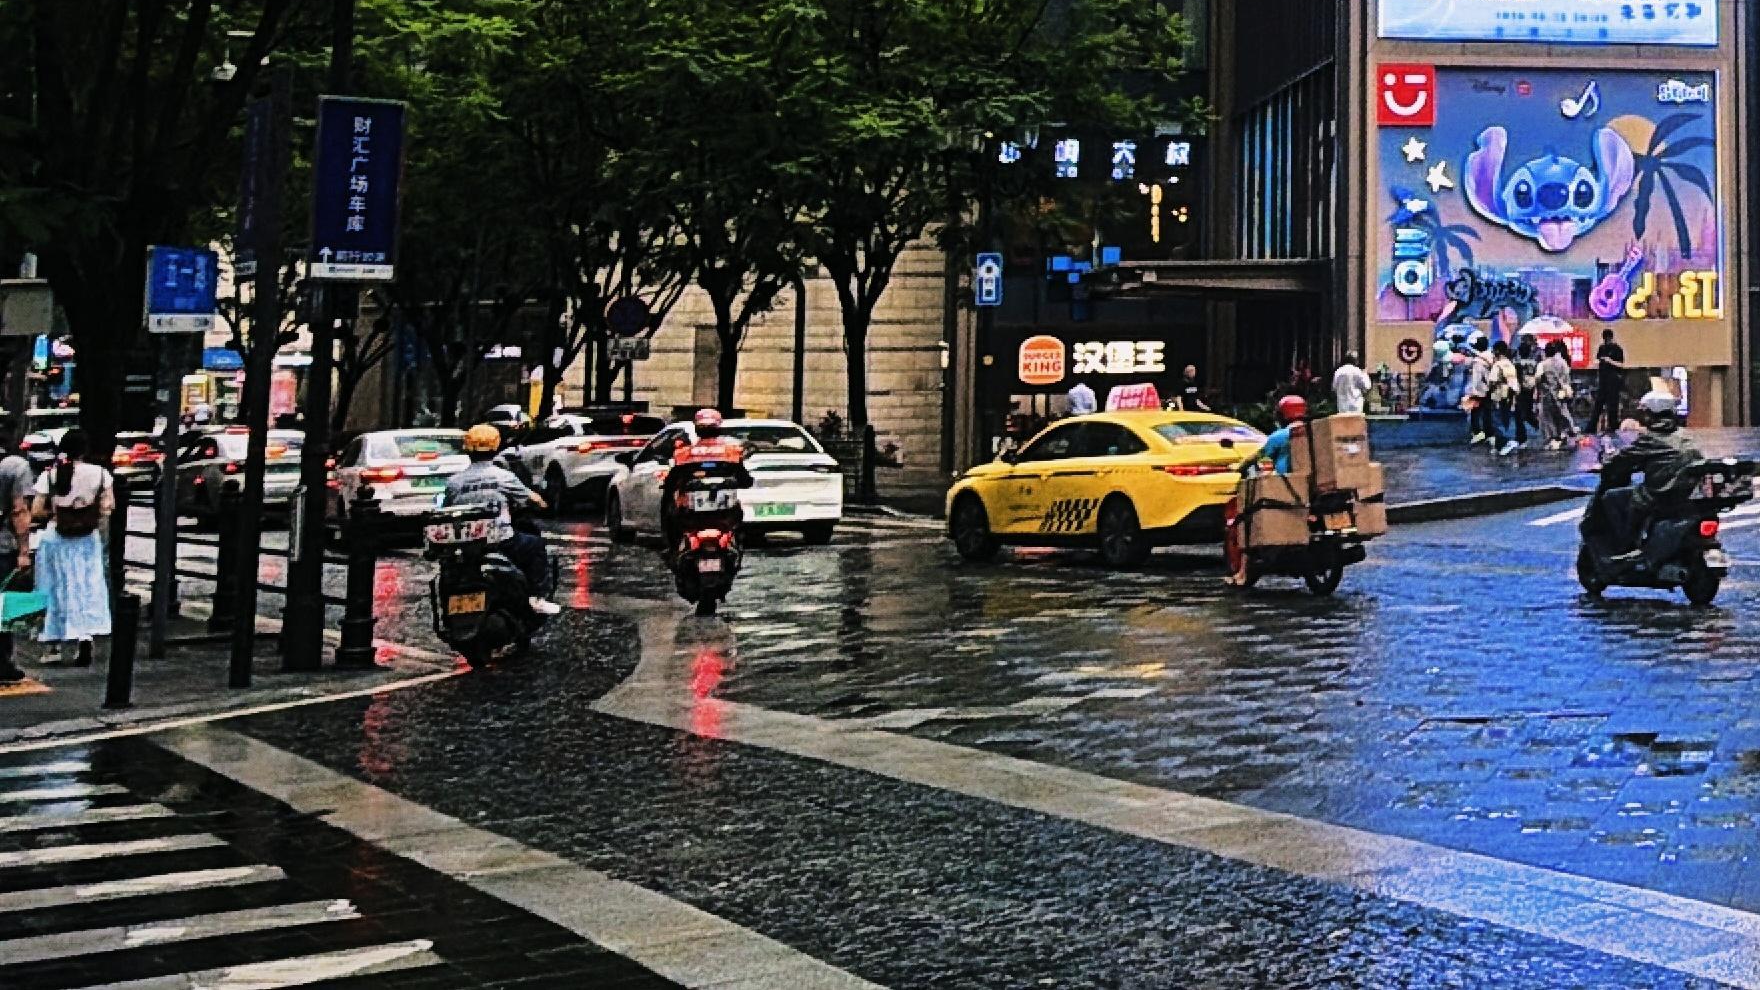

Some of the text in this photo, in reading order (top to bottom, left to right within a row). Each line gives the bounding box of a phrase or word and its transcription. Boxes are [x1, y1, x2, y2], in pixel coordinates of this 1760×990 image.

[1022, 361, 1062, 373] KING
[1072, 340, 1166, 374] 汉堡王
